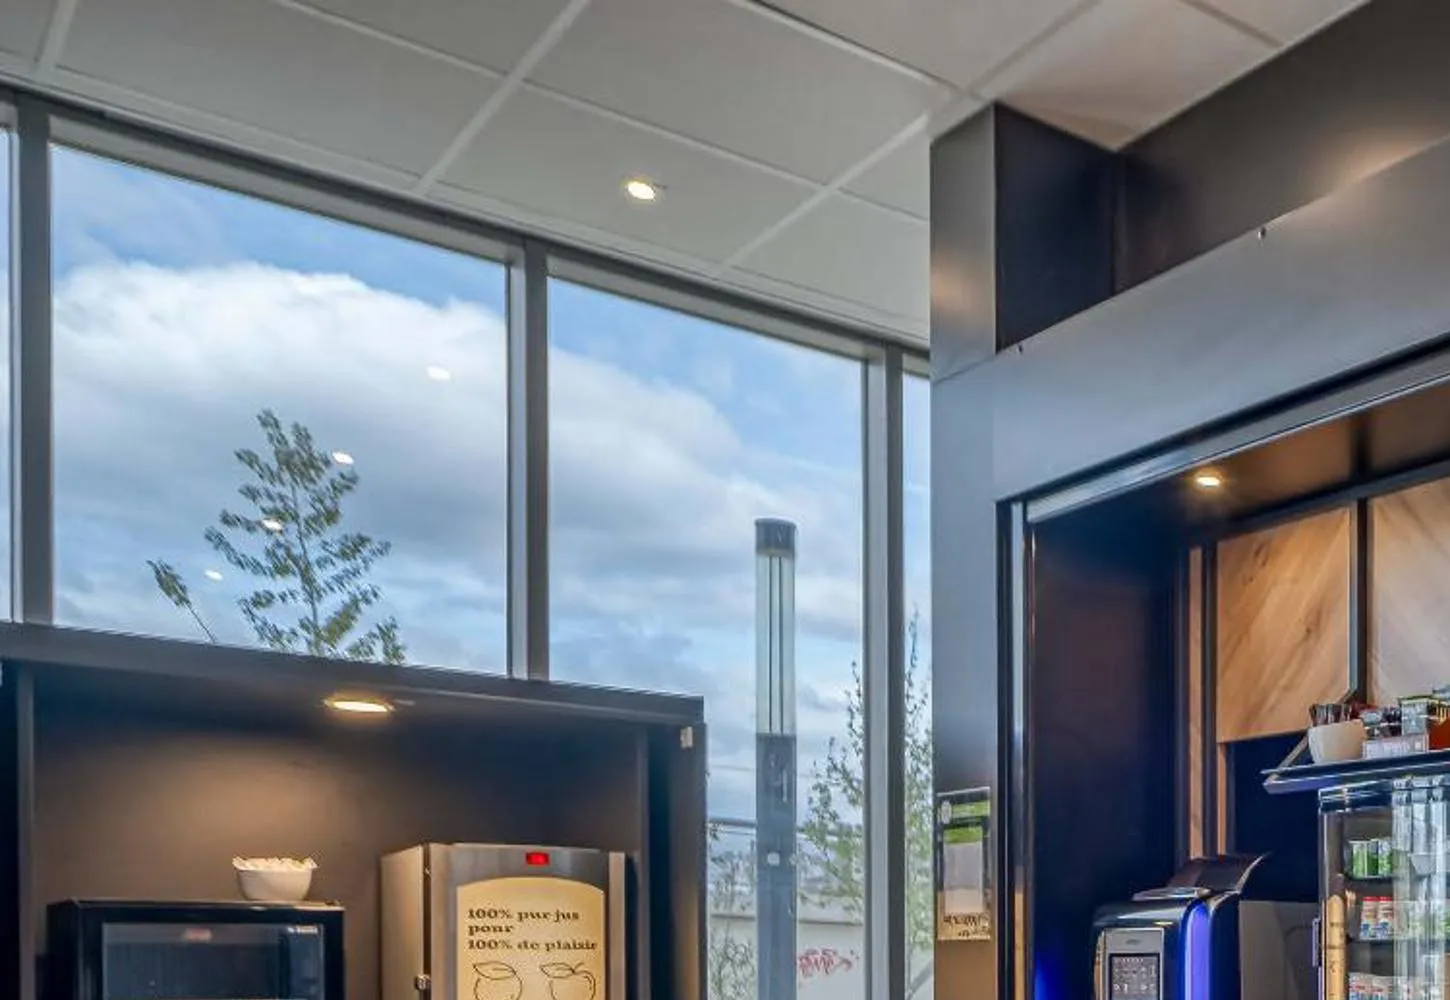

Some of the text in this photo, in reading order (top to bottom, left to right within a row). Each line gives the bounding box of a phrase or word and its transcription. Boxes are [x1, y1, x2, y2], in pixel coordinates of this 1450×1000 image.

[467, 908, 580, 923] 100% pur jus
[467, 924, 514, 936] pour
[467, 939, 598, 952] 100% de plaisir
